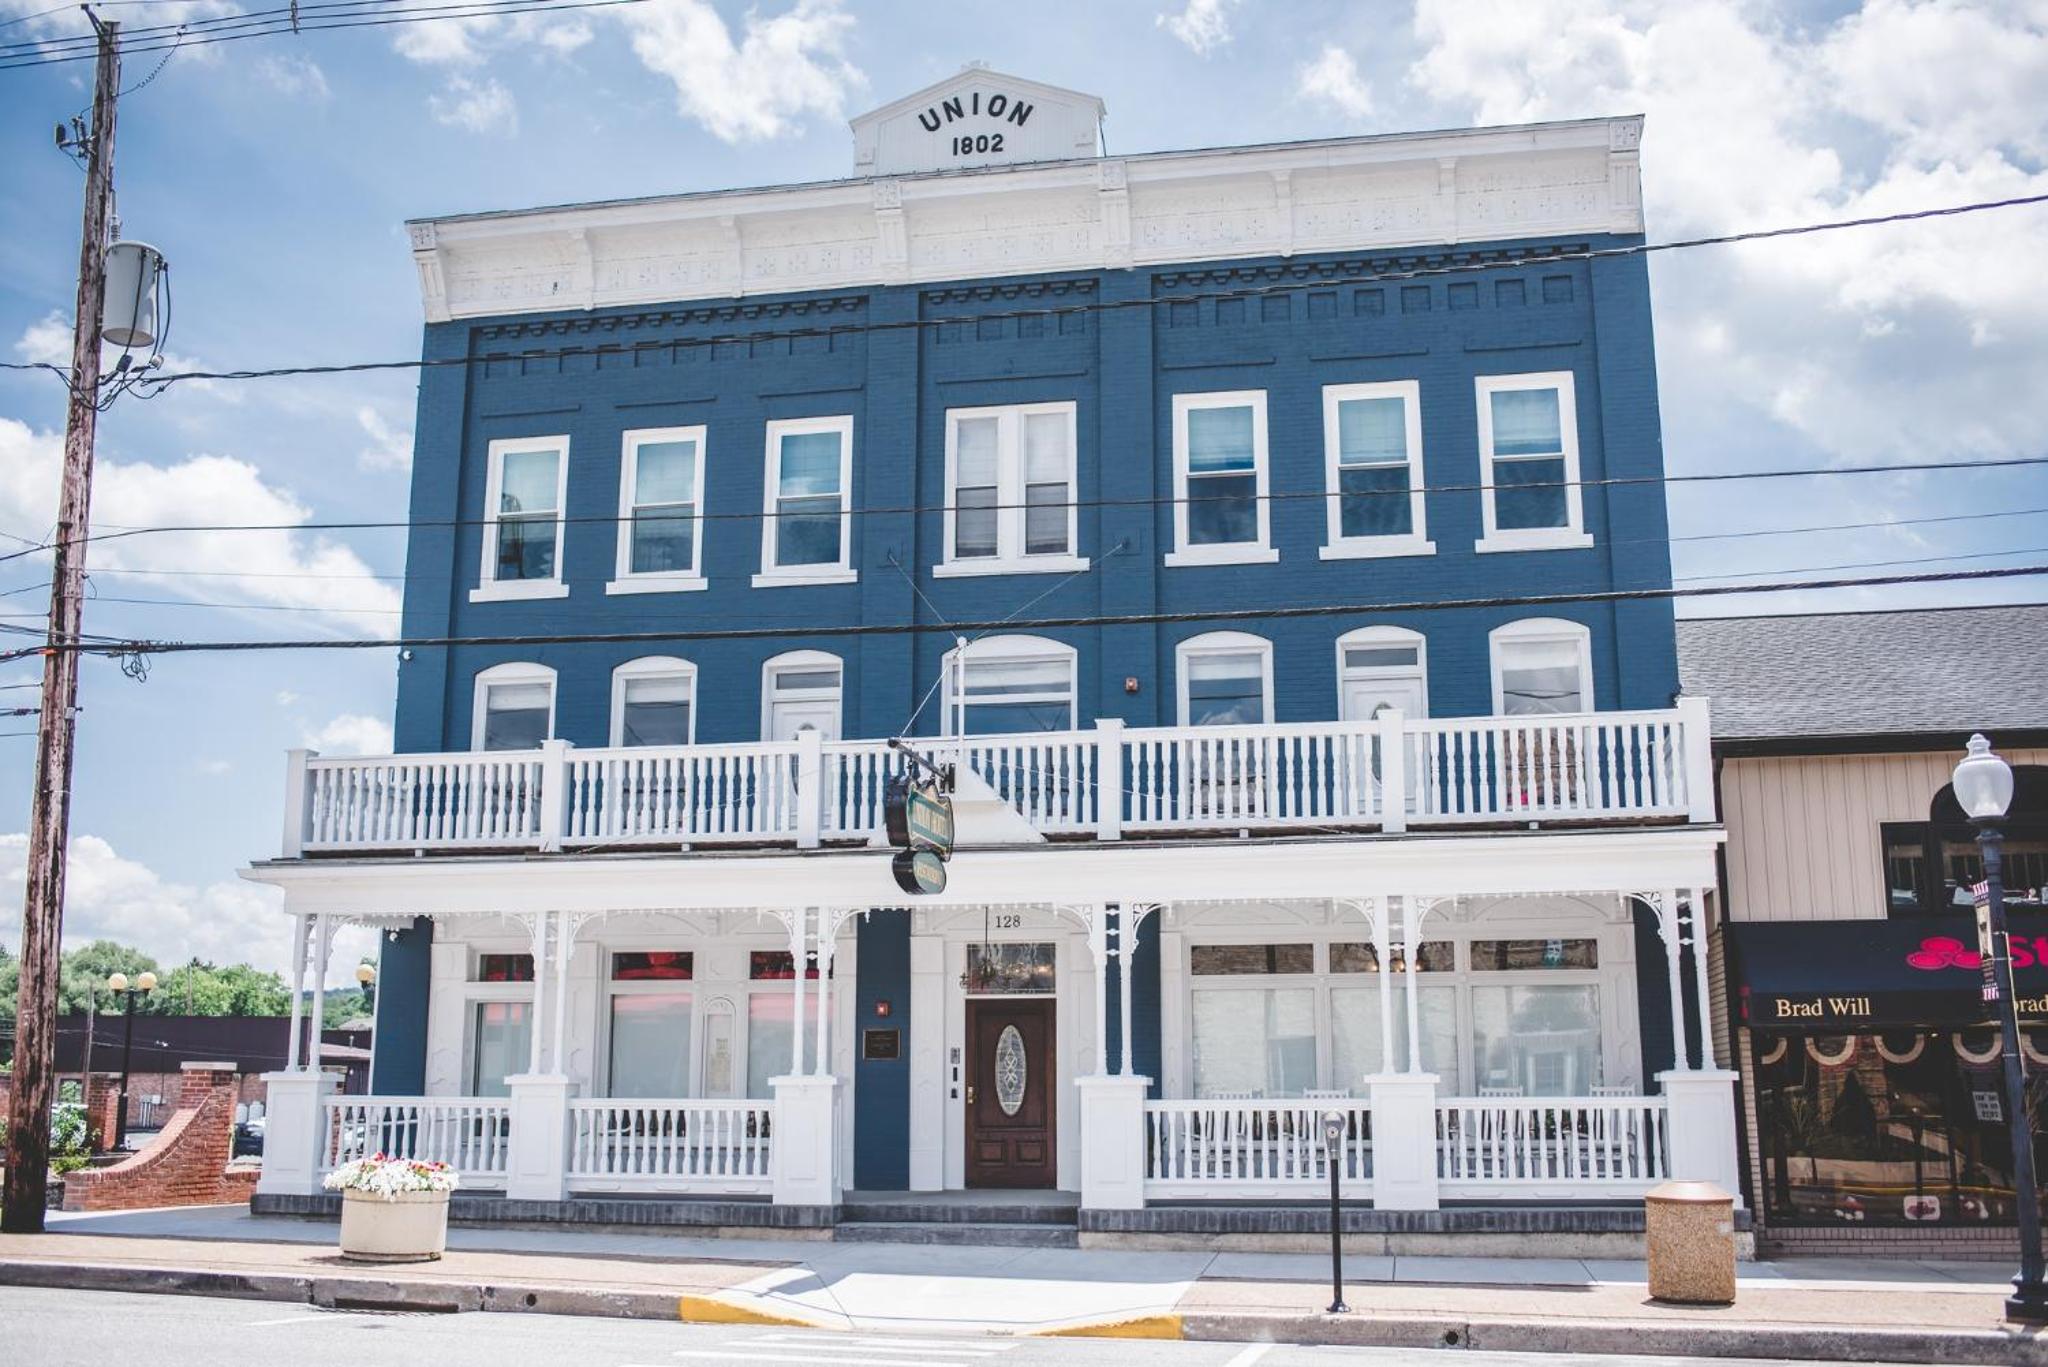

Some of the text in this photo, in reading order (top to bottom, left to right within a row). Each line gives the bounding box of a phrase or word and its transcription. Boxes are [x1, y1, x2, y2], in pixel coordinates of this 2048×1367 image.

[918, 92, 1034, 132] UNION
[953, 133, 1004, 156] 1802
[995, 914, 1021, 928] 128
[1775, 997, 1872, 1017] Brad Will
[2013, 994, 2048, 1013] rad
